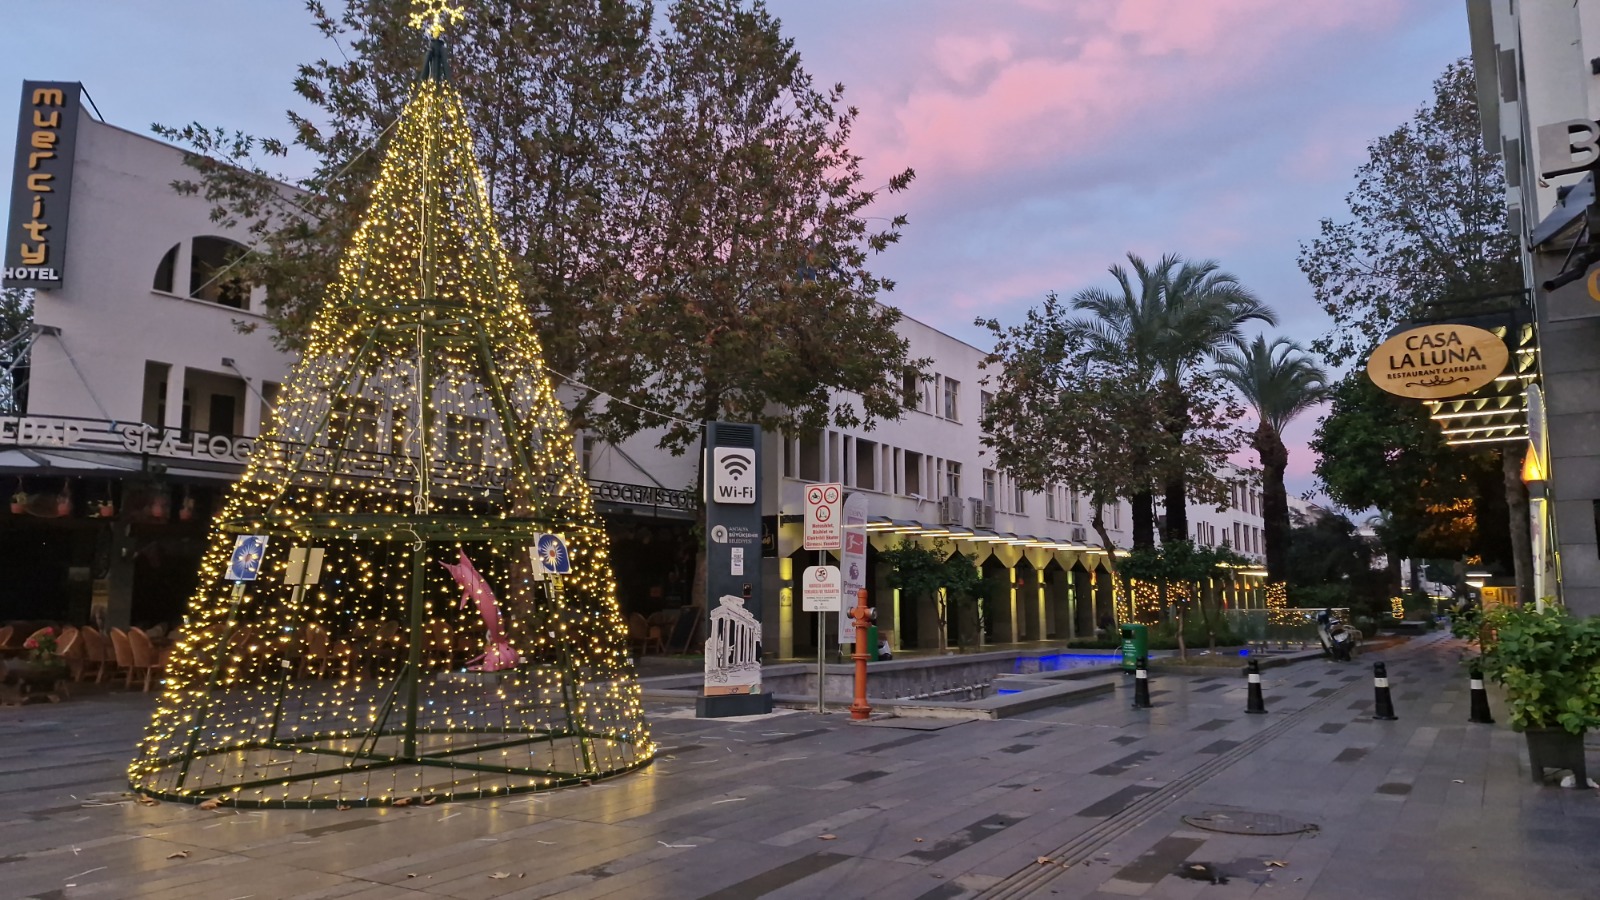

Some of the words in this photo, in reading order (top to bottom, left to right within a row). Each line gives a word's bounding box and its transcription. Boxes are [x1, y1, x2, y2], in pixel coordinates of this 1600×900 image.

[3, 267, 58, 280] HOTEL
[1405, 331, 1462, 351] CASA
[1389, 353, 1415, 370] LA
[1420, 346, 1482, 367] LUNA
[1387, 368, 1440, 379] RESTAURANT
[1442, 364, 1487, 375] CAFE&BAR
[123, 425, 181, 456] SEA
[192, 431, 260, 462] FOO
[599, 482, 667, 506] COCKTAILS
[719, 485, 753, 499] Wi-Fi
[843, 580, 863, 590] Premier
